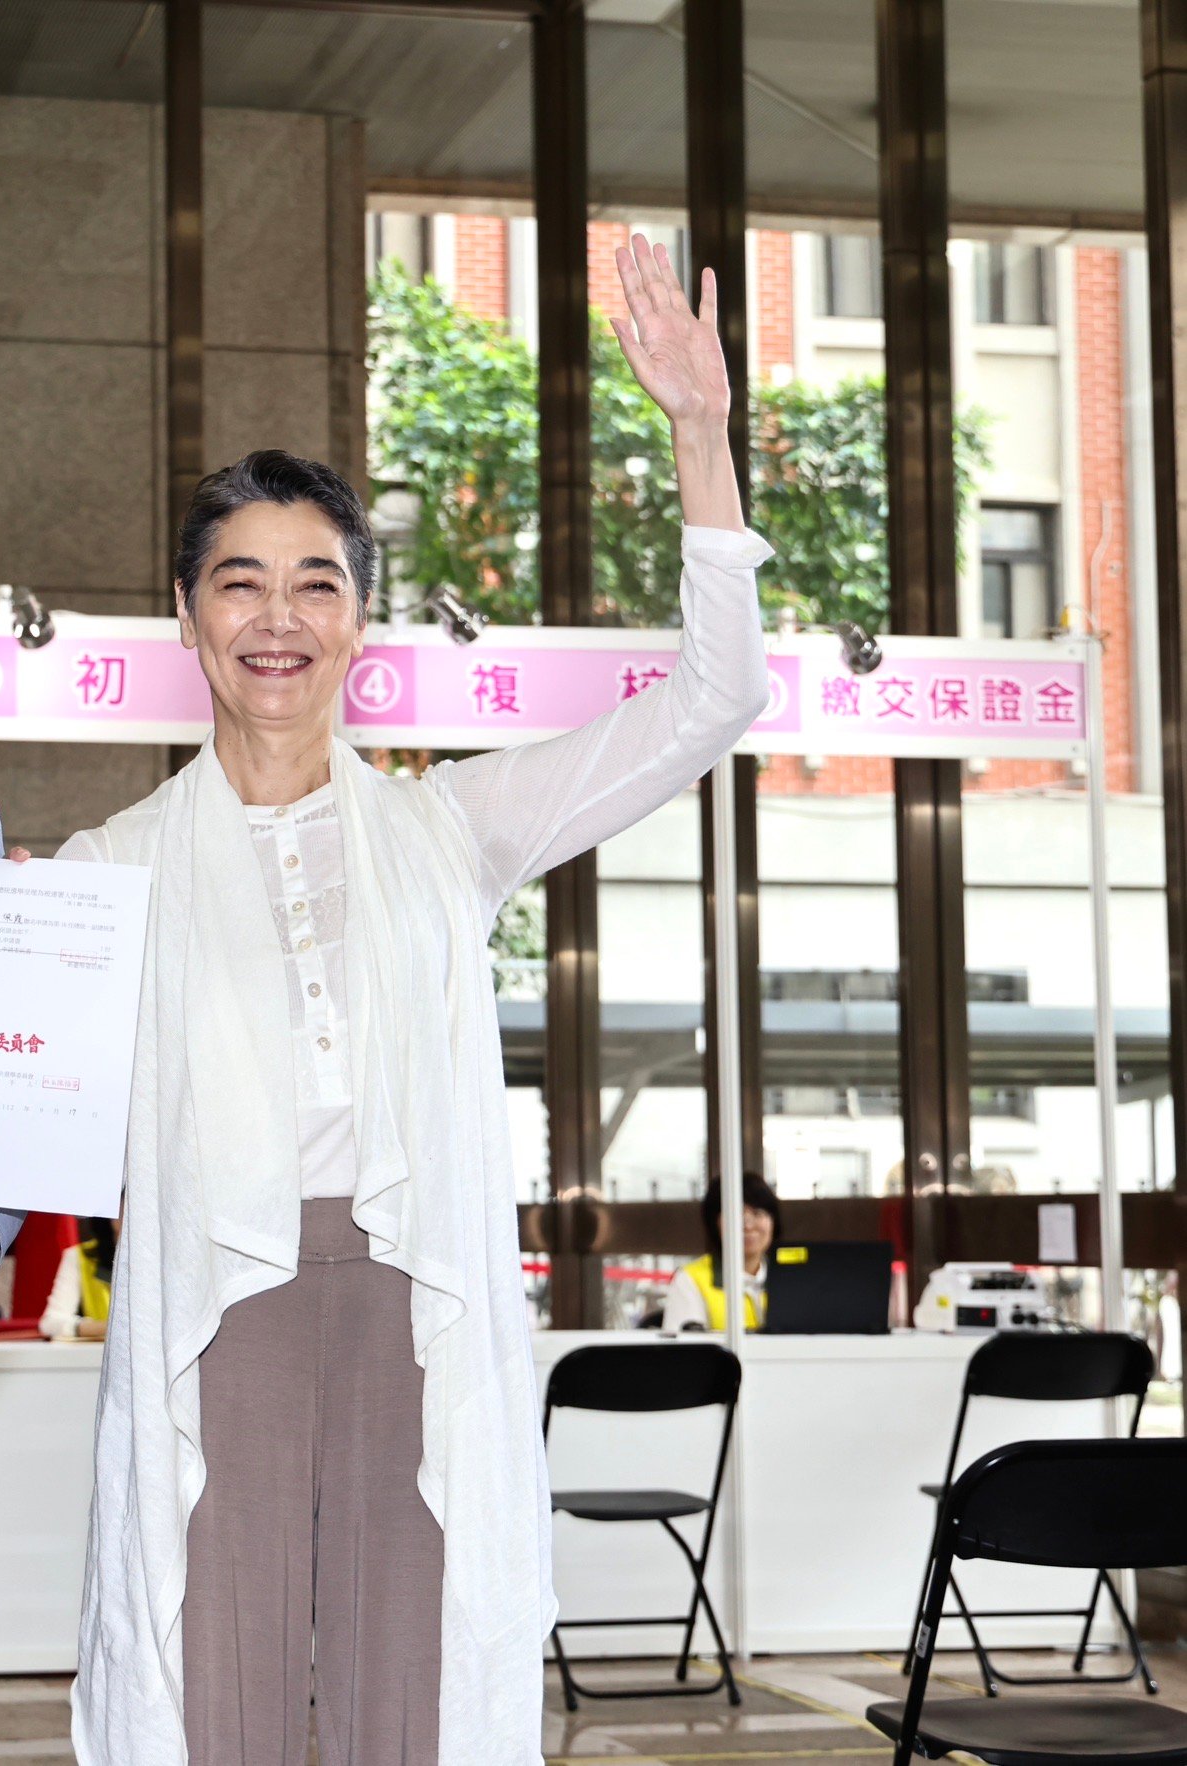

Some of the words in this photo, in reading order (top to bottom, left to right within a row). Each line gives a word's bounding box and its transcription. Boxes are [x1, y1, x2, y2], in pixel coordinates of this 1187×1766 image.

[76, 654, 125, 705] 初
[472, 664, 520, 713] 複
[821, 675, 1076, 723] 繳交保證金
